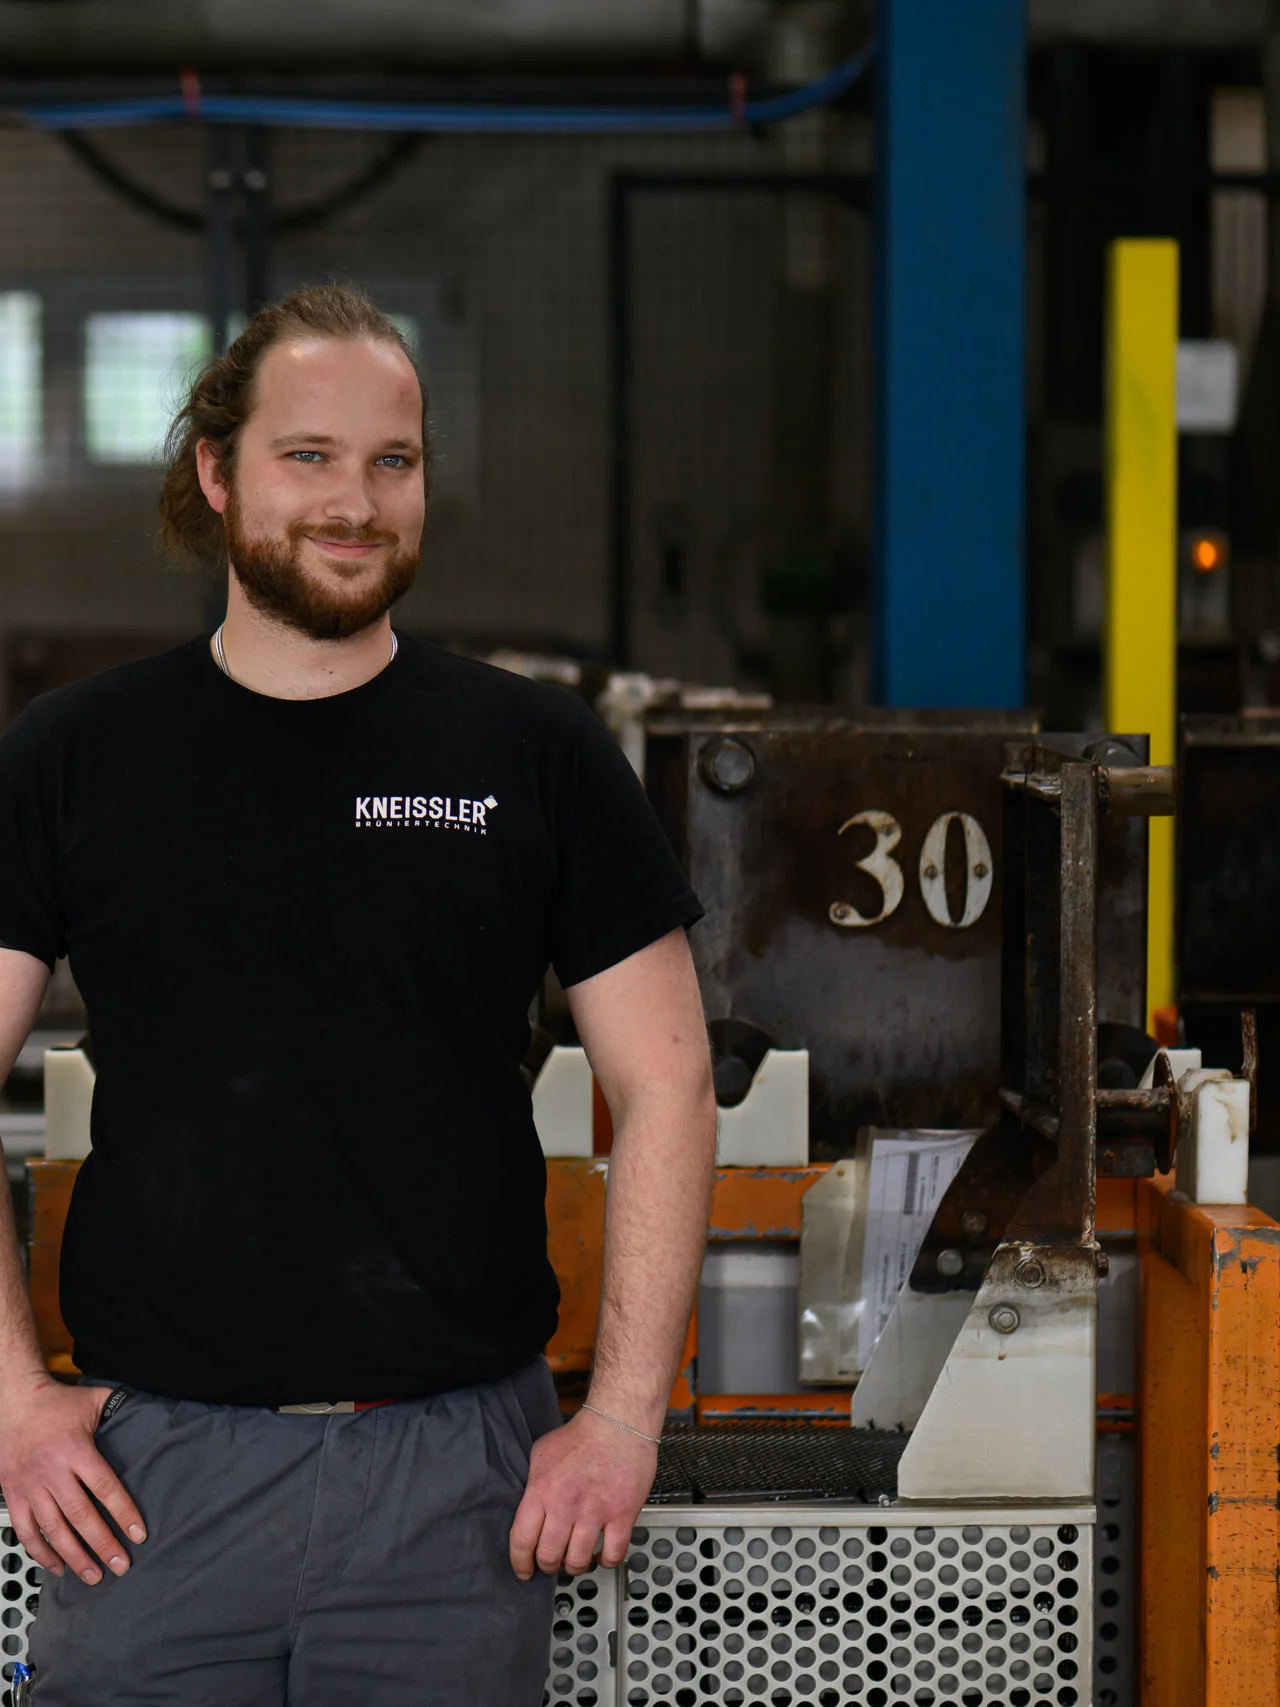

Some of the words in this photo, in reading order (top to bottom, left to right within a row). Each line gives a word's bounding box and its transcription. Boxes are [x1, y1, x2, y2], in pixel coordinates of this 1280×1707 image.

[355, 796, 486, 826] KNEISSLER
[355, 820, 487, 836] BRÜNIERTECHNIK
[828, 809, 993, 929] 30
